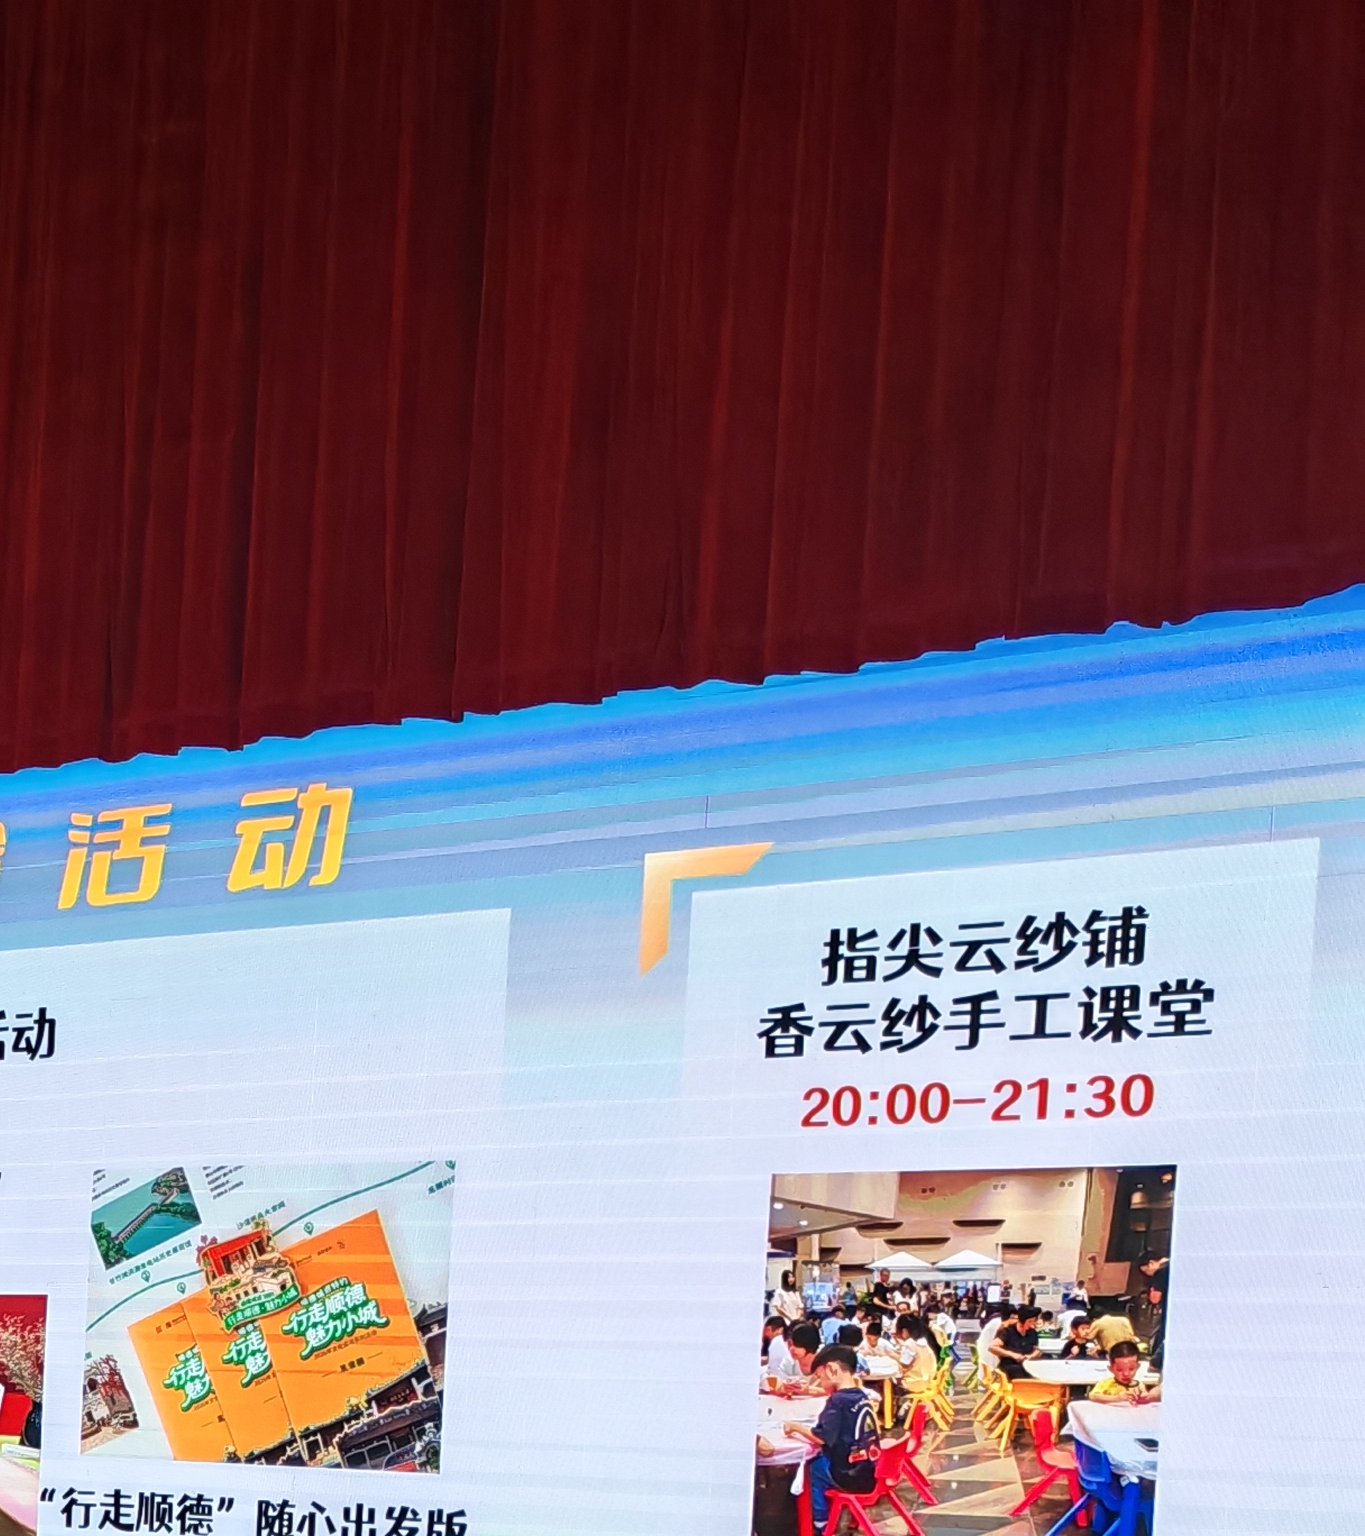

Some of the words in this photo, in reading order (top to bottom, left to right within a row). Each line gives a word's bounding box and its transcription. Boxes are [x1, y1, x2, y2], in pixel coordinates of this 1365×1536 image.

[822, 905, 1151, 988] 指尖云纱铺
[757, 978, 1214, 1059] 香云纱手工课堂
[801, 1073, 1155, 1129] 20:00-21:30
